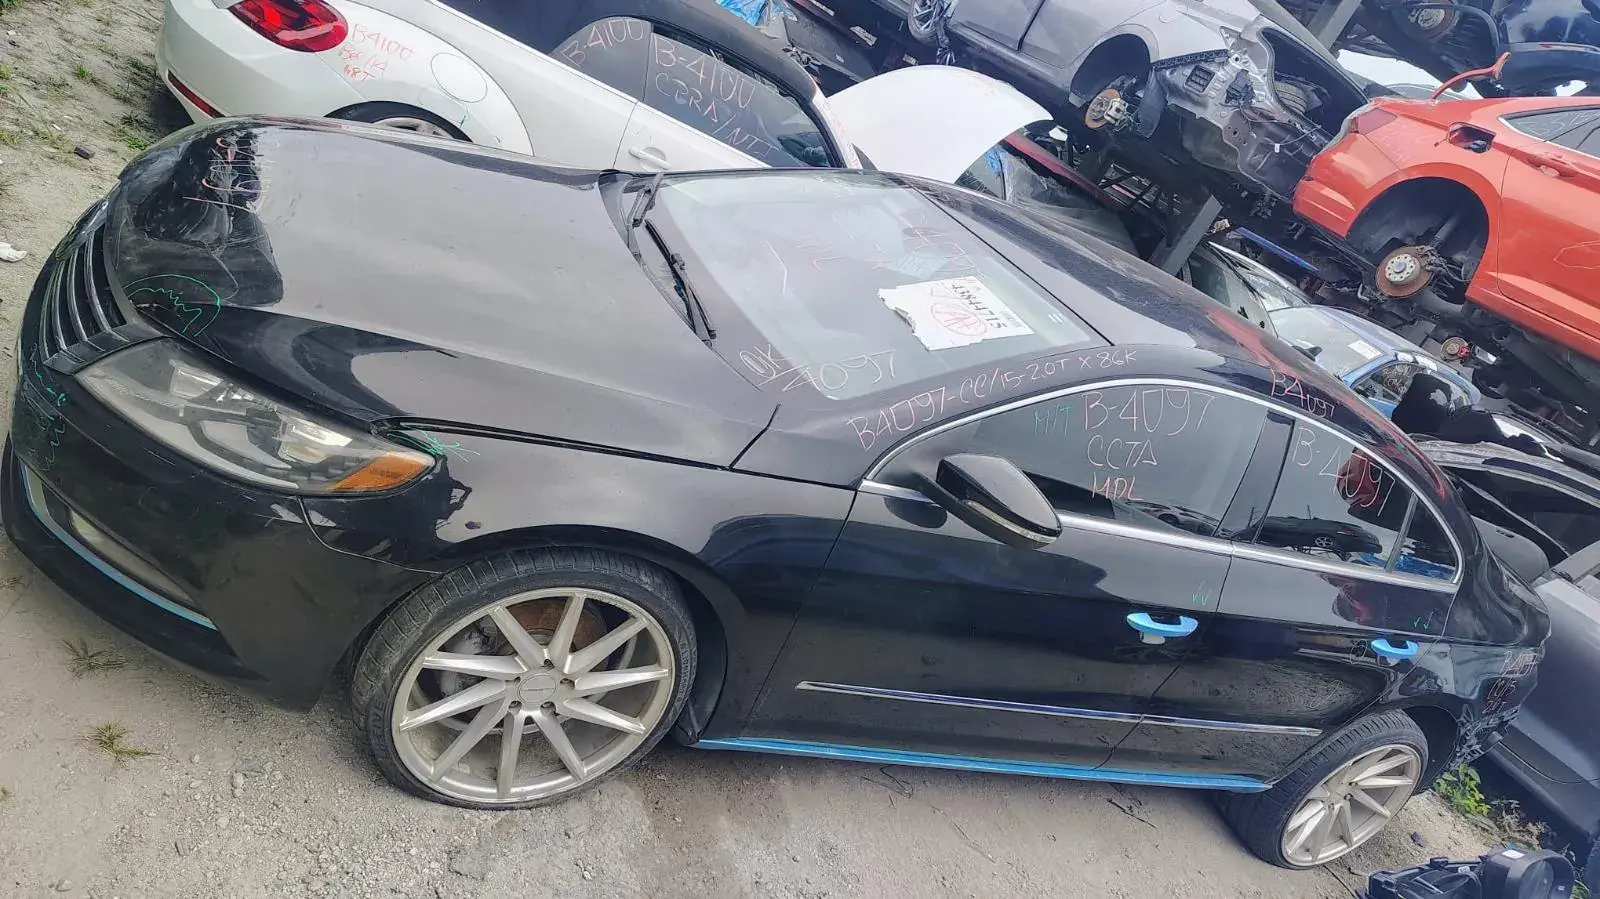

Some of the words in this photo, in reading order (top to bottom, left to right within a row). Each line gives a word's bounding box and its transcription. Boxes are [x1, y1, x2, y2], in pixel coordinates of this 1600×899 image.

[1081, 389, 1216, 436] B-4097
[1086, 434, 1158, 470] CCTA
[1292, 426, 1396, 517] B-4097
